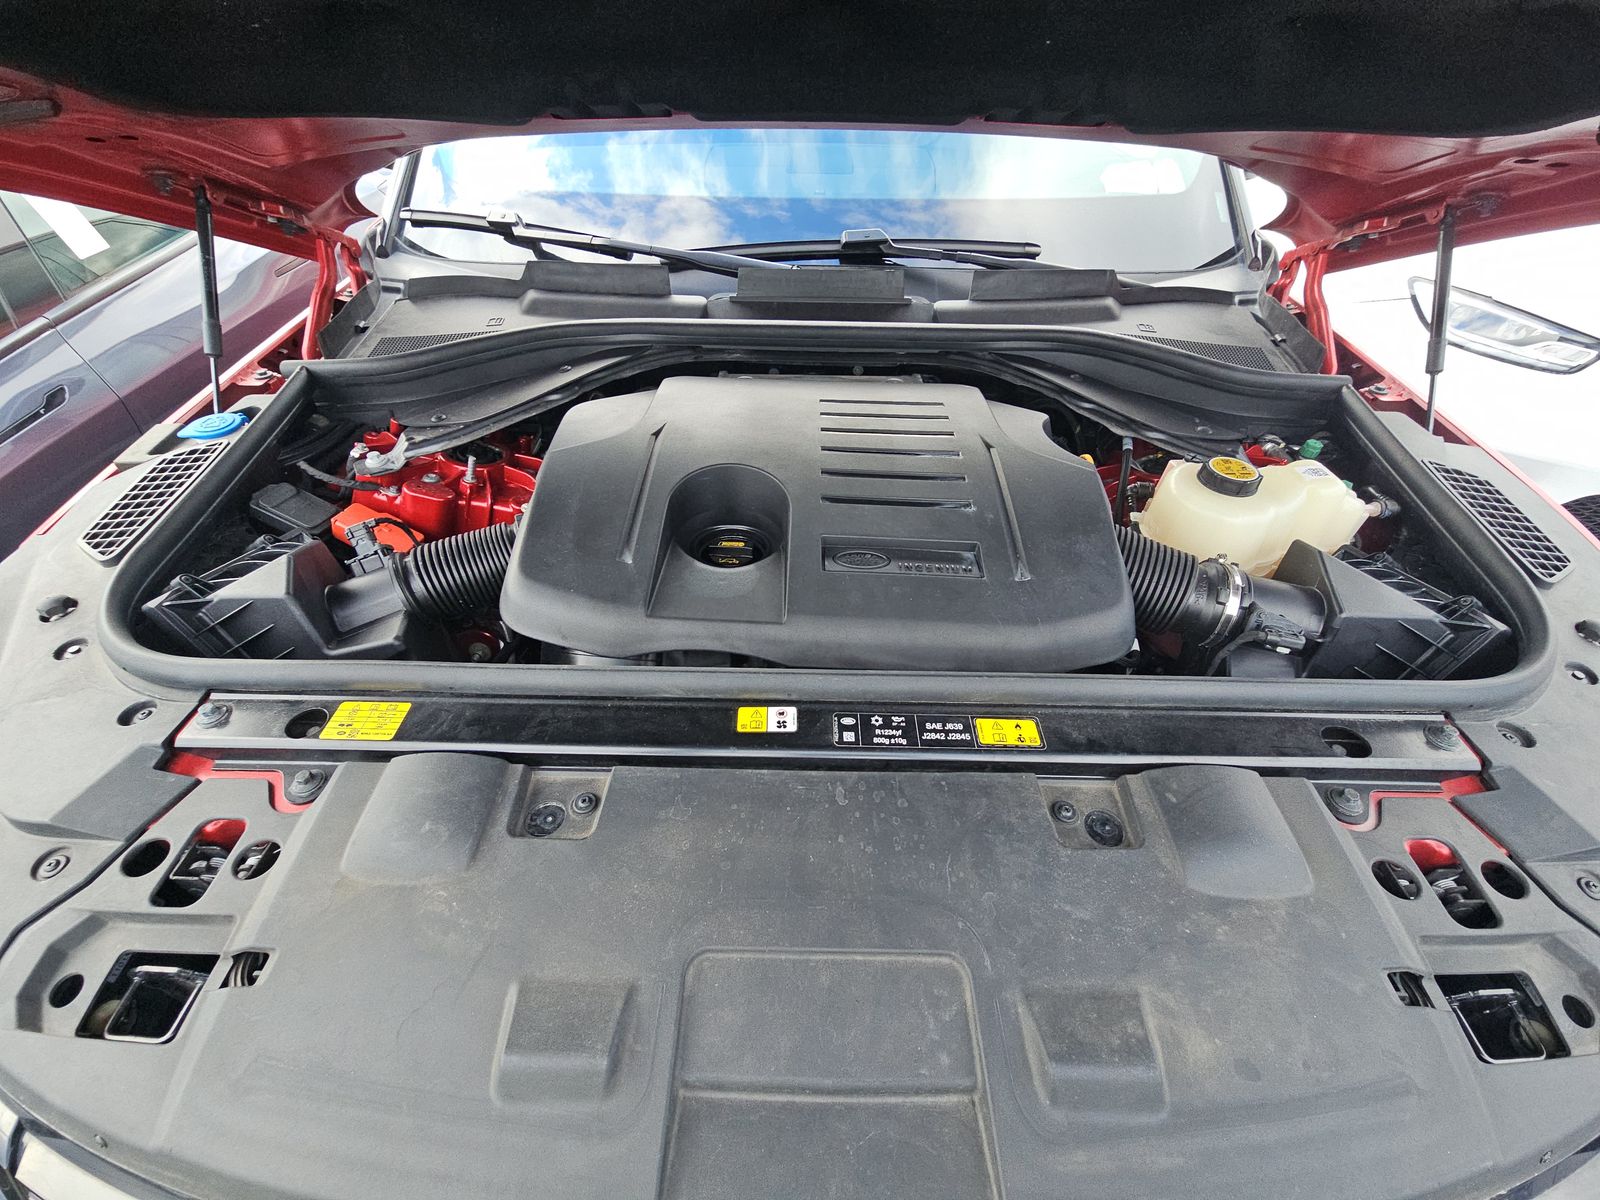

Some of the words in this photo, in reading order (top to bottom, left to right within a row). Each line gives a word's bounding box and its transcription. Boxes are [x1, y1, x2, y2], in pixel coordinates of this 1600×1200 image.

[898, 562, 973, 574] INGENIUM
[925, 722, 943, 730] SAE
[945, 722, 964, 730] J639
[875, 729, 903, 737] R1234yf
[921, 732, 946, 740] J2842
[947, 732, 971, 741] J2845
